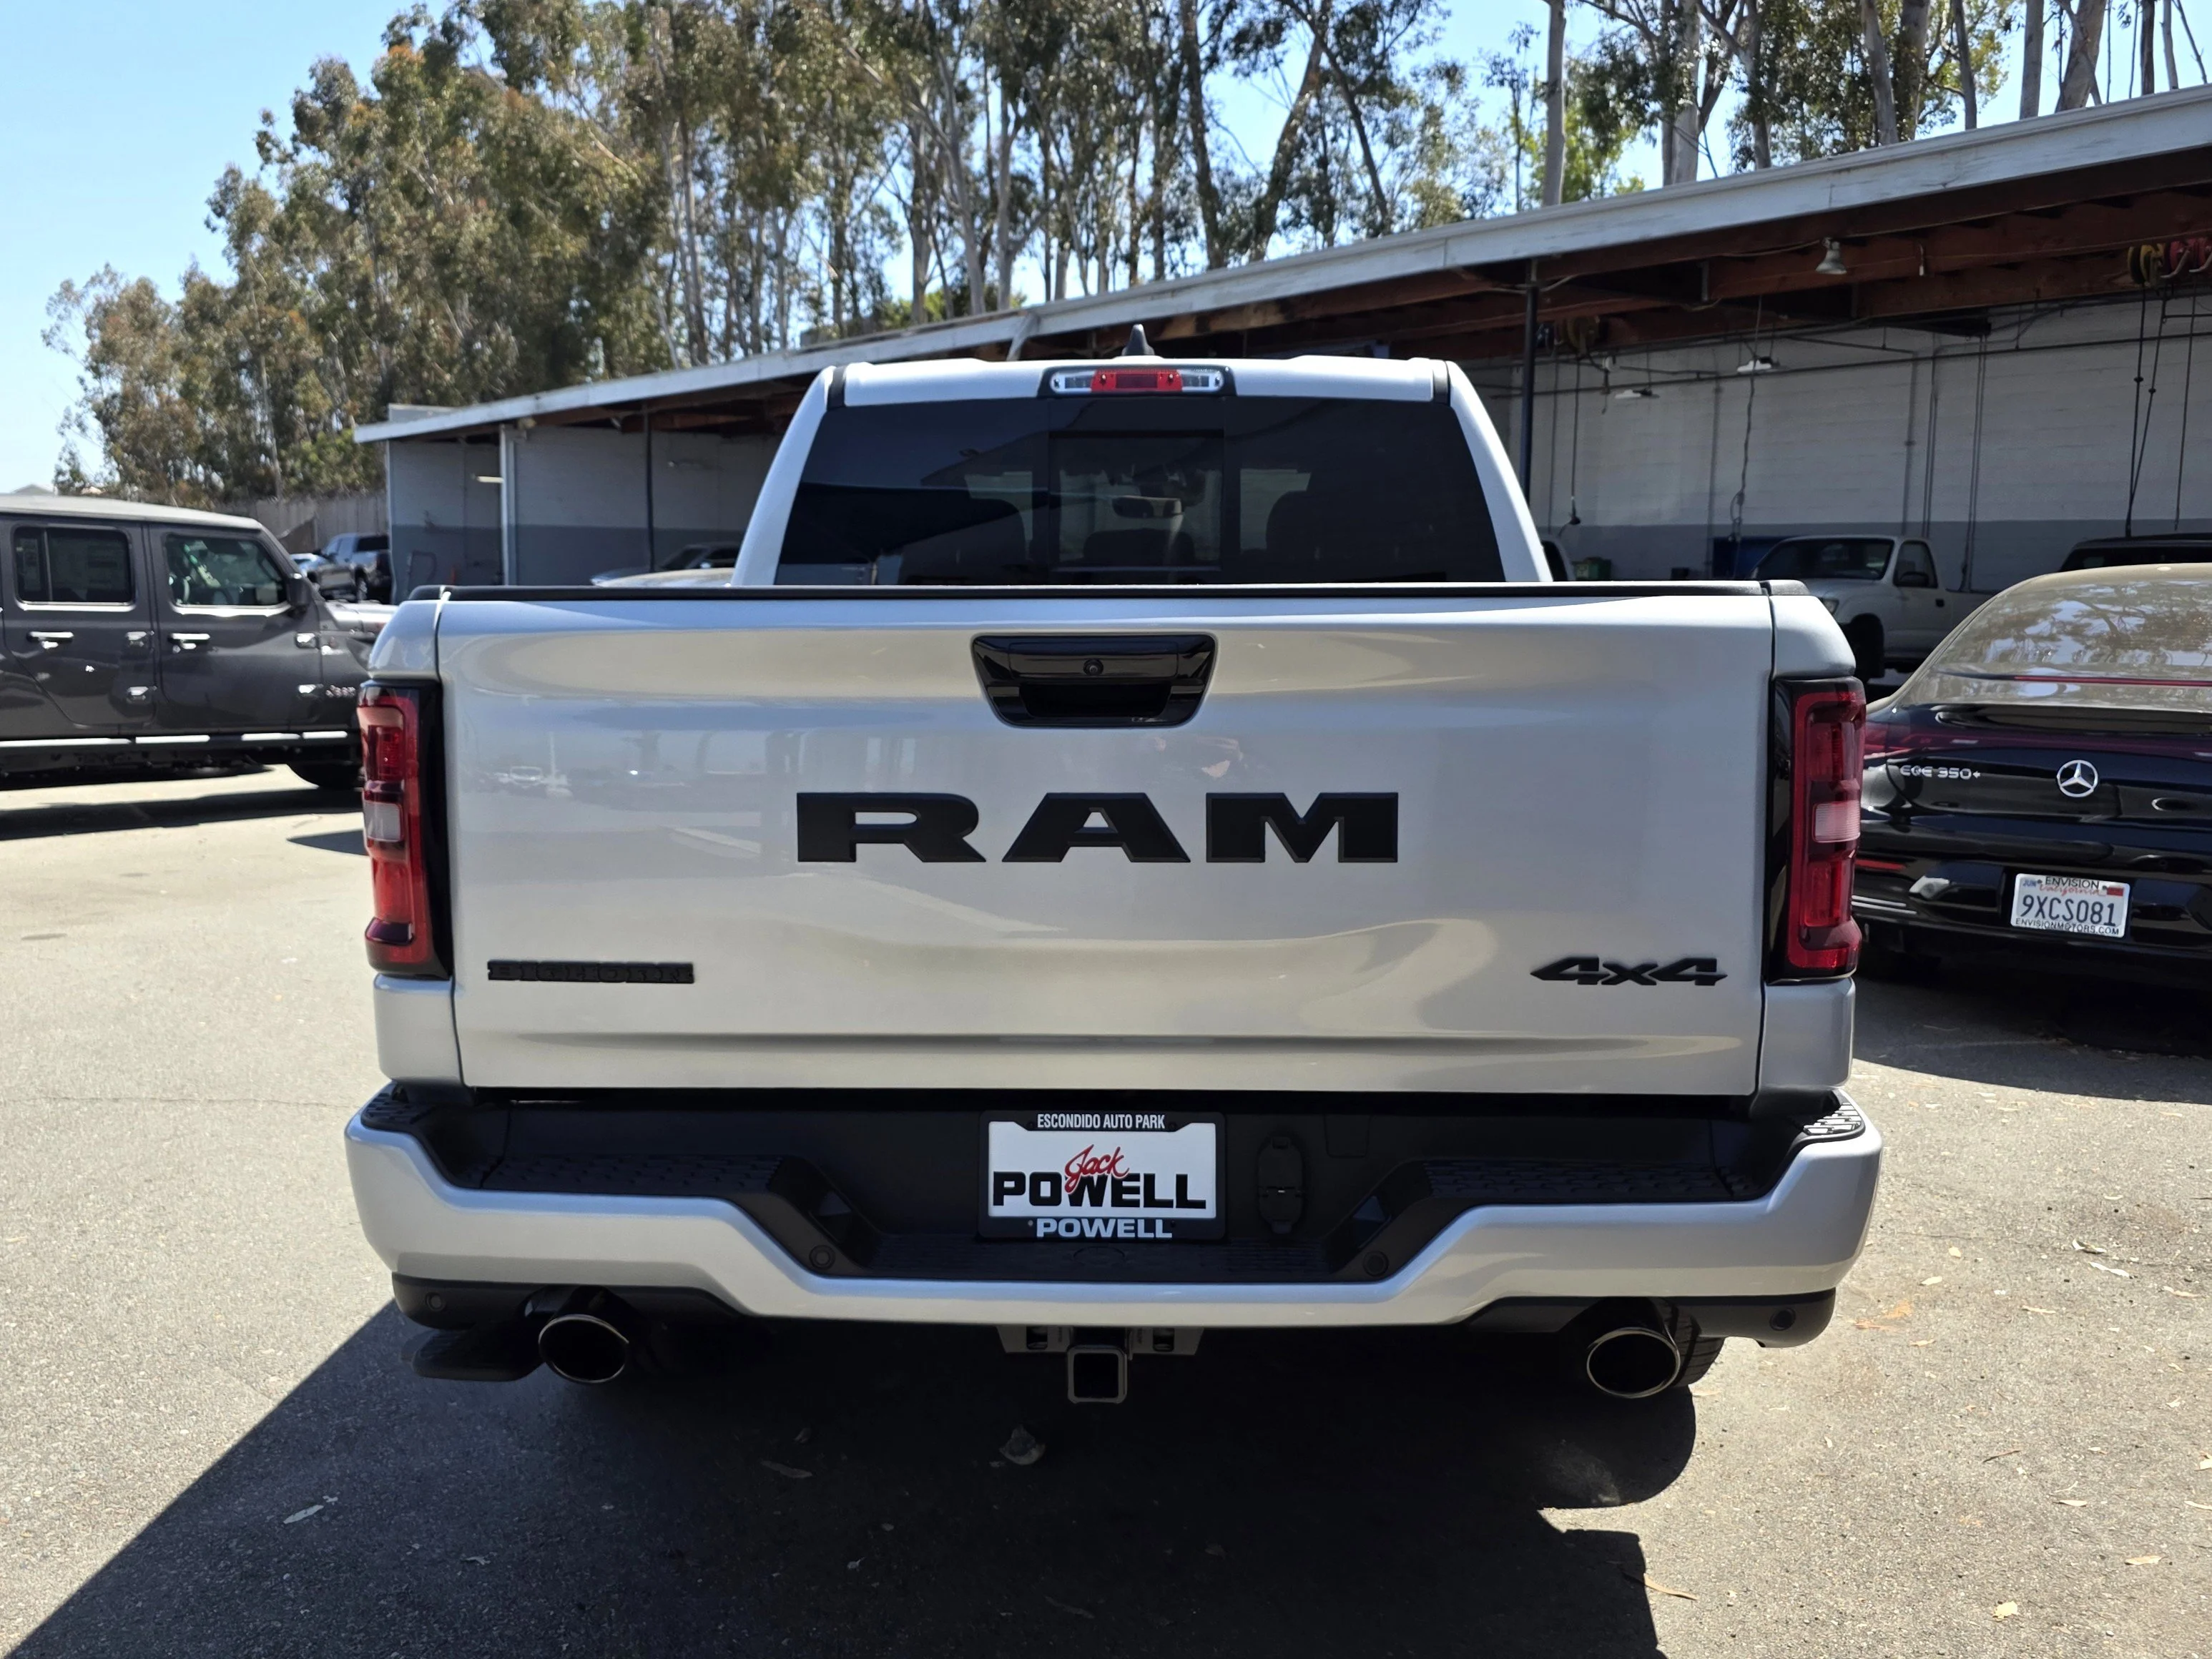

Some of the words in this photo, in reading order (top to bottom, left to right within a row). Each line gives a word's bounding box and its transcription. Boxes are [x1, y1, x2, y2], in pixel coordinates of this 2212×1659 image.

[1899, 764, 1933, 777] EQE
[1937, 767, 1981, 780] 350+
[797, 792, 1399, 863] RAM
[2045, 876, 2100, 889] ENVISION
[2020, 895, 2116, 927] 9XCS081
[2015, 917, 2119, 935] ENVISIONMOTORS.COM
[1037, 1113, 1101, 1129] ESCONDIDO
[1103, 1114, 1132, 1129] AUTO
[1136, 1114, 1165, 1130] PARK
[1064, 1144, 1129, 1193] Jack
[993, 1171, 1206, 1209] POWELL
[1036, 1218, 1172, 1239] POWELL
